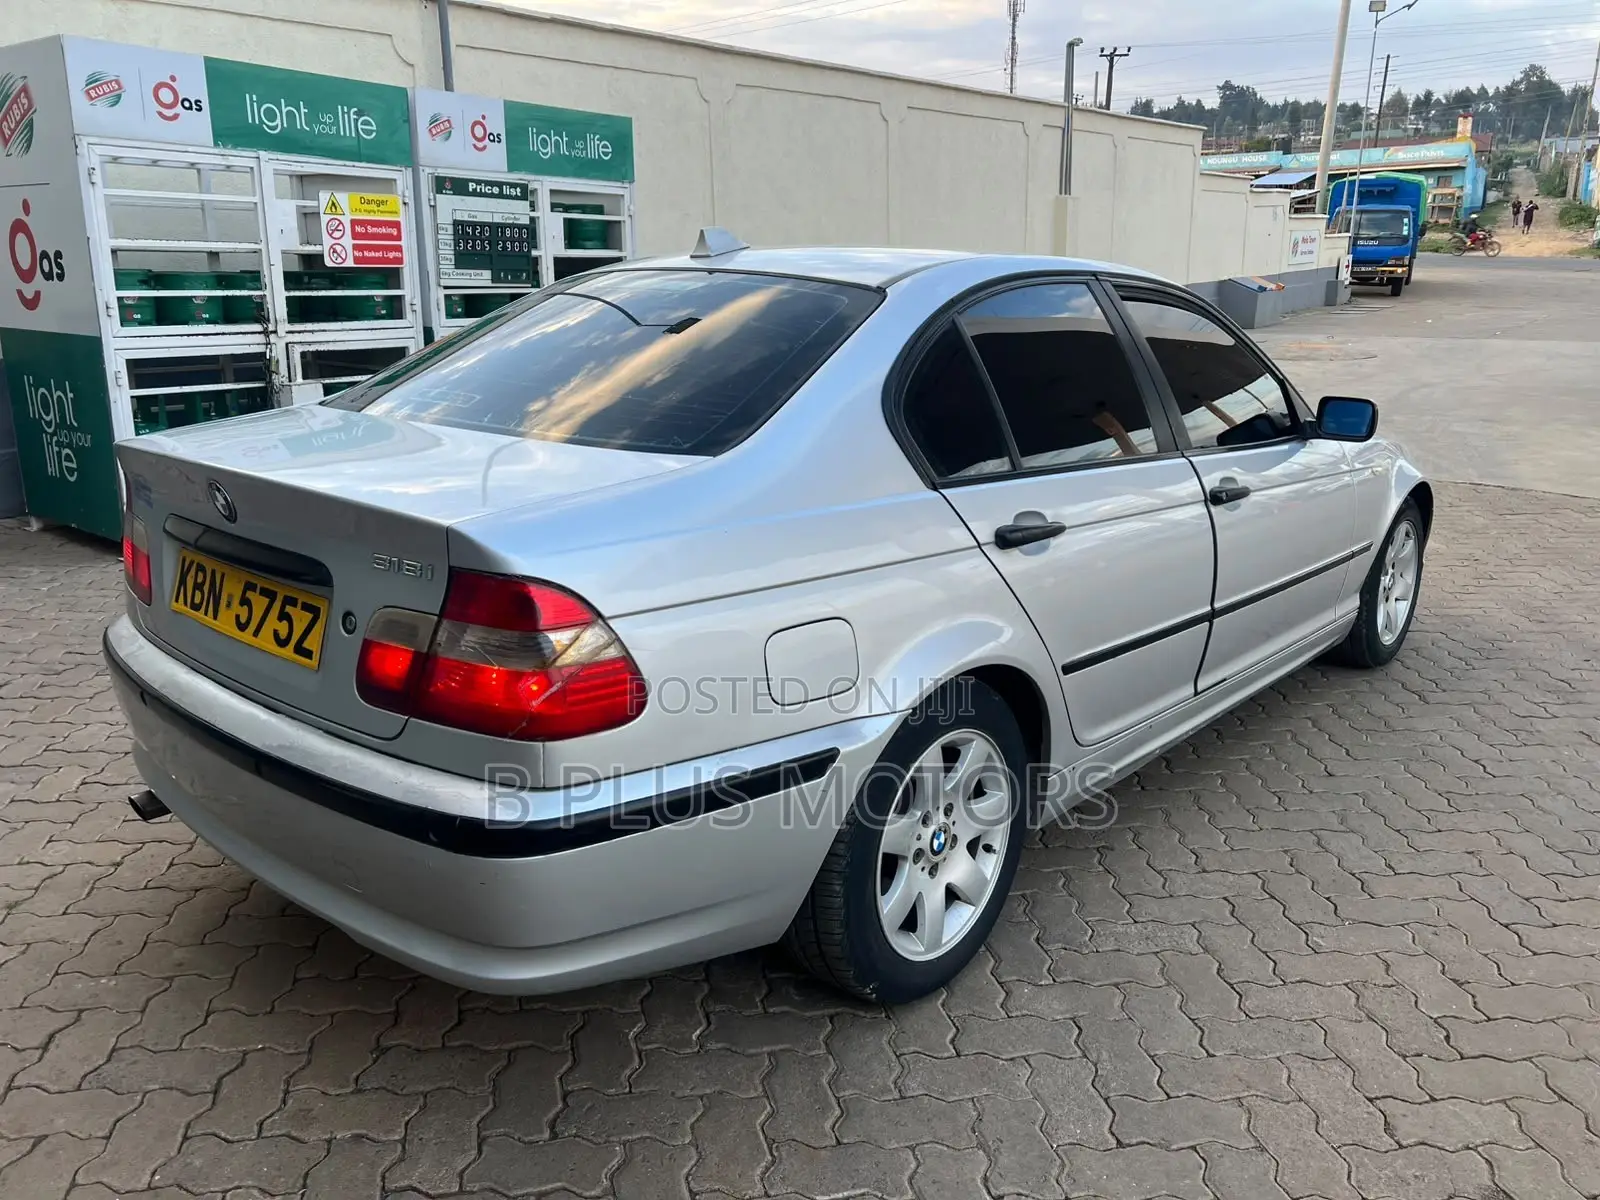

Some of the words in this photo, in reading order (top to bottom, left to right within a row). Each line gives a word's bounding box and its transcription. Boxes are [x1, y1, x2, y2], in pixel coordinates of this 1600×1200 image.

[88, 80, 119, 99] RUBIS
[152, 74, 203, 122] gas
[1, 90, 29, 139] RUBIS
[245, 93, 310, 134] light
[319, 112, 334, 124] up
[337, 105, 377, 139] life
[313, 123, 337, 135] your
[470, 114, 502, 152] gas
[528, 127, 570, 159] light
[570, 148, 586, 158] your
[574, 140, 585, 148] up
[586, 133, 612, 160] life
[359, 196, 389, 207] Danger
[468, 182, 500, 194] Price
[502, 185, 522, 197] list
[355, 225, 366, 233] No
[367, 225, 398, 236] Smoking
[457, 225, 490, 236] 1420
[498, 227, 528, 238] 1800
[9, 198, 65, 311] gas
[458, 239, 490, 251] 3205
[497, 241, 529, 252] 2900
[24, 374, 78, 433] light
[57, 428, 70, 445] up
[71, 430, 92, 448] your
[42, 432, 78, 482] life
[371, 552, 434, 581] 318i
[174, 555, 226, 621] KBN
[234, 579, 322, 661] 575Z
